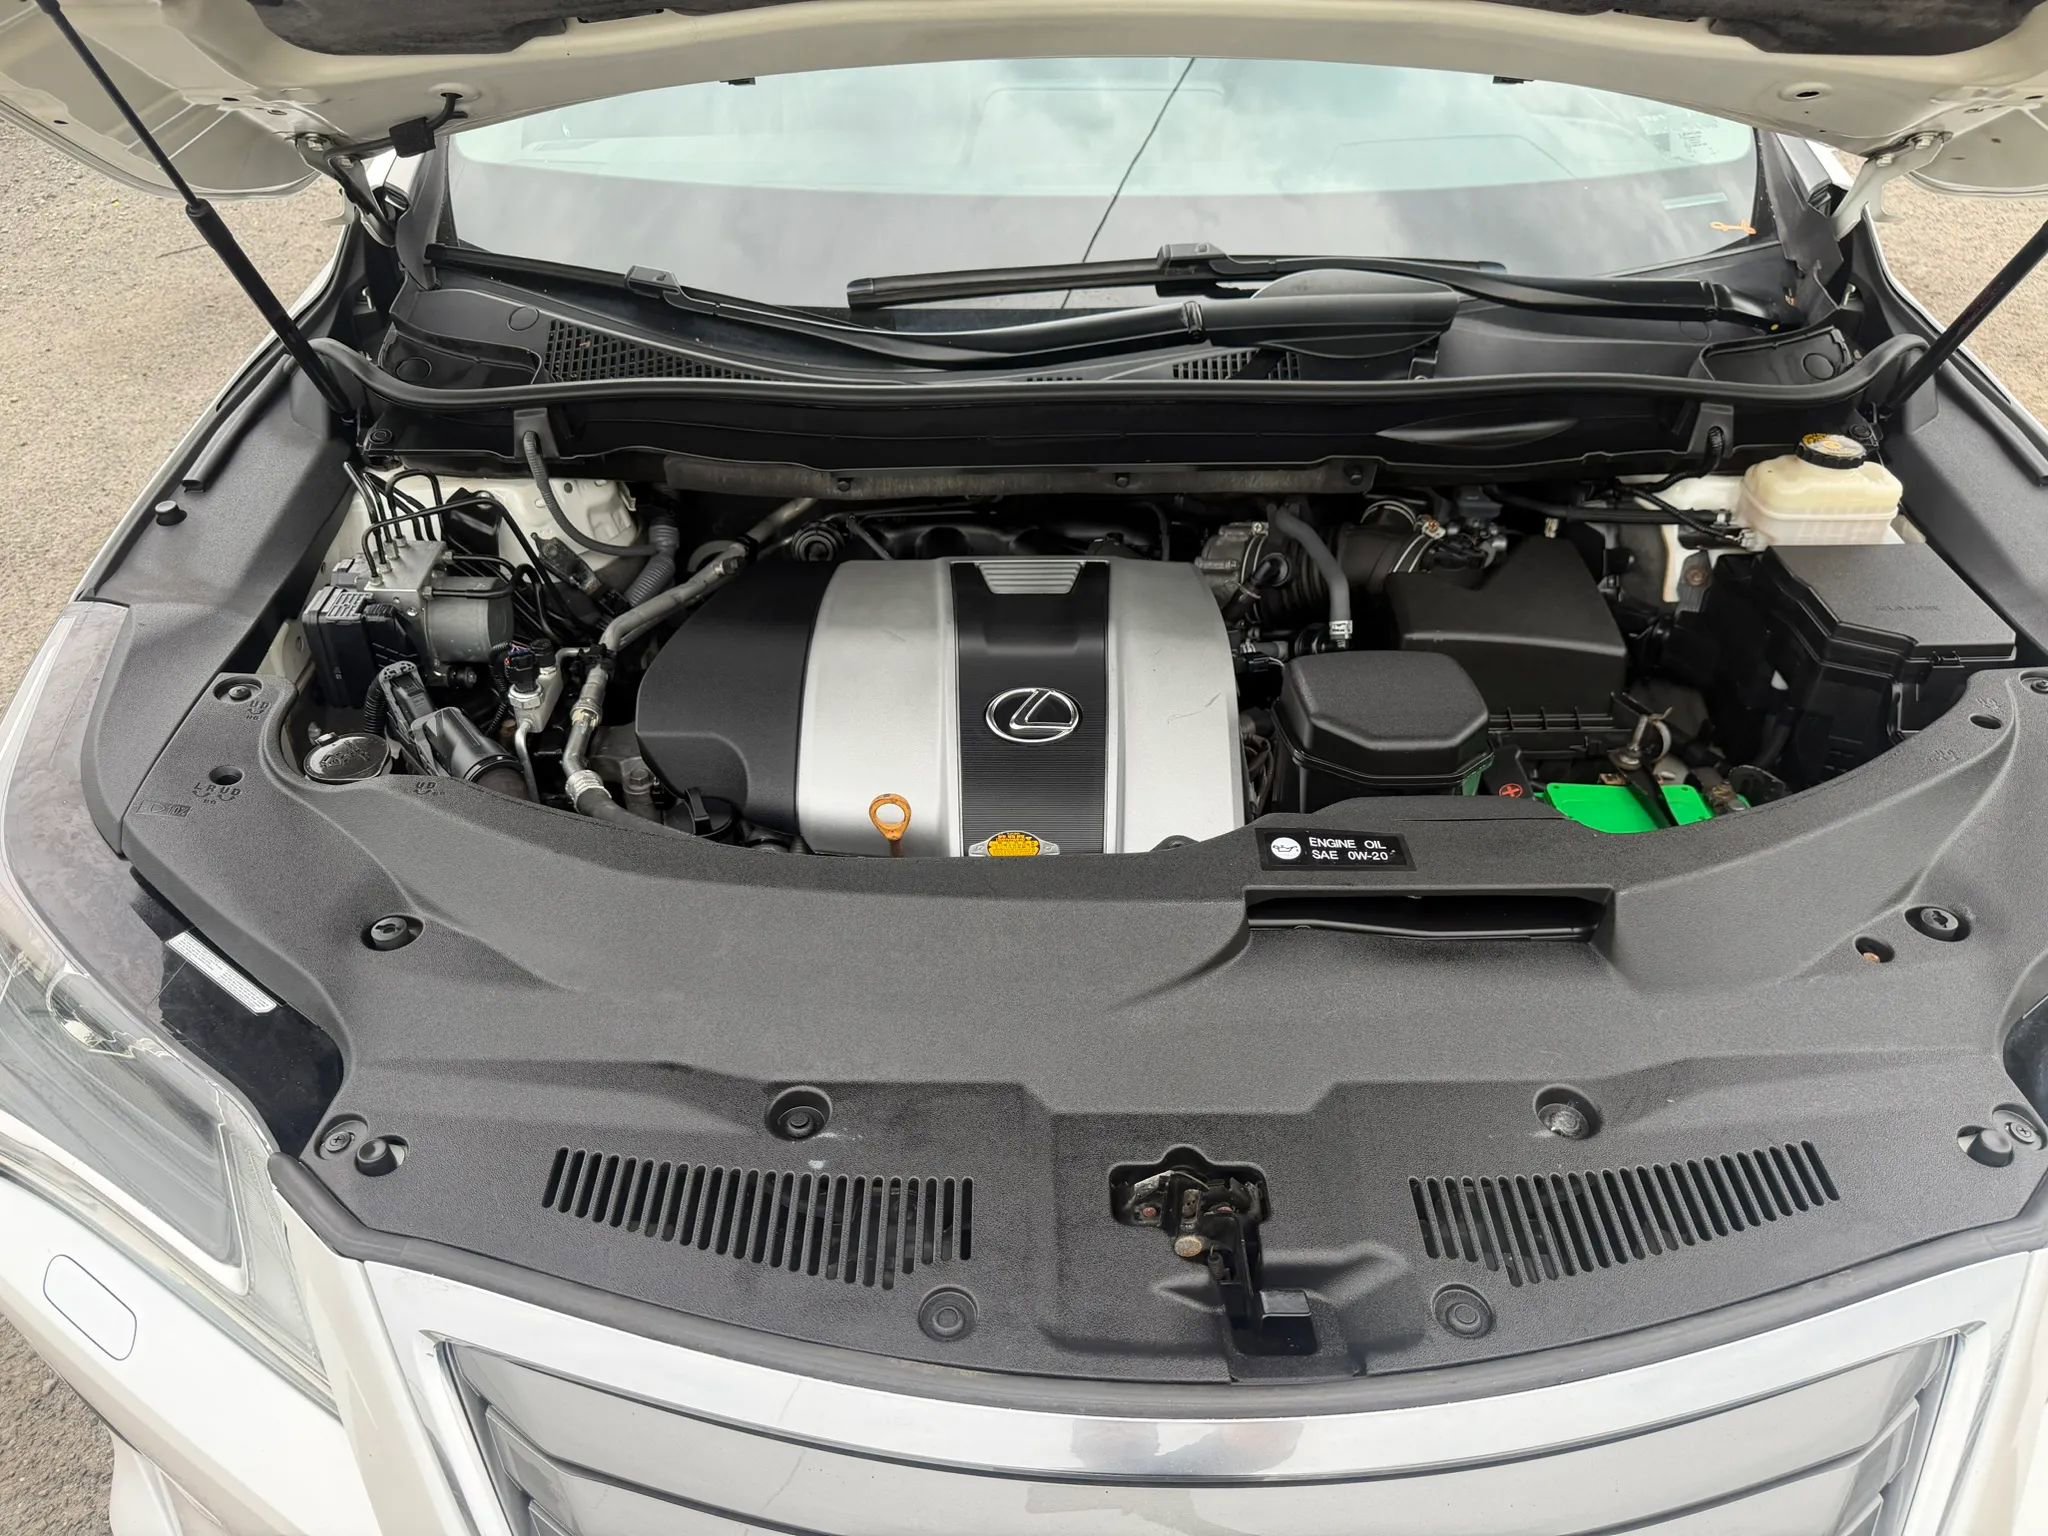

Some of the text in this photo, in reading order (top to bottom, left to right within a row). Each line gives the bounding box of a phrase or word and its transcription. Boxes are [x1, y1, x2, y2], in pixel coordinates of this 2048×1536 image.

[1308, 836, 1387, 850] ENGINE OIL
[1311, 849, 1389, 861] SAE 0W-20
